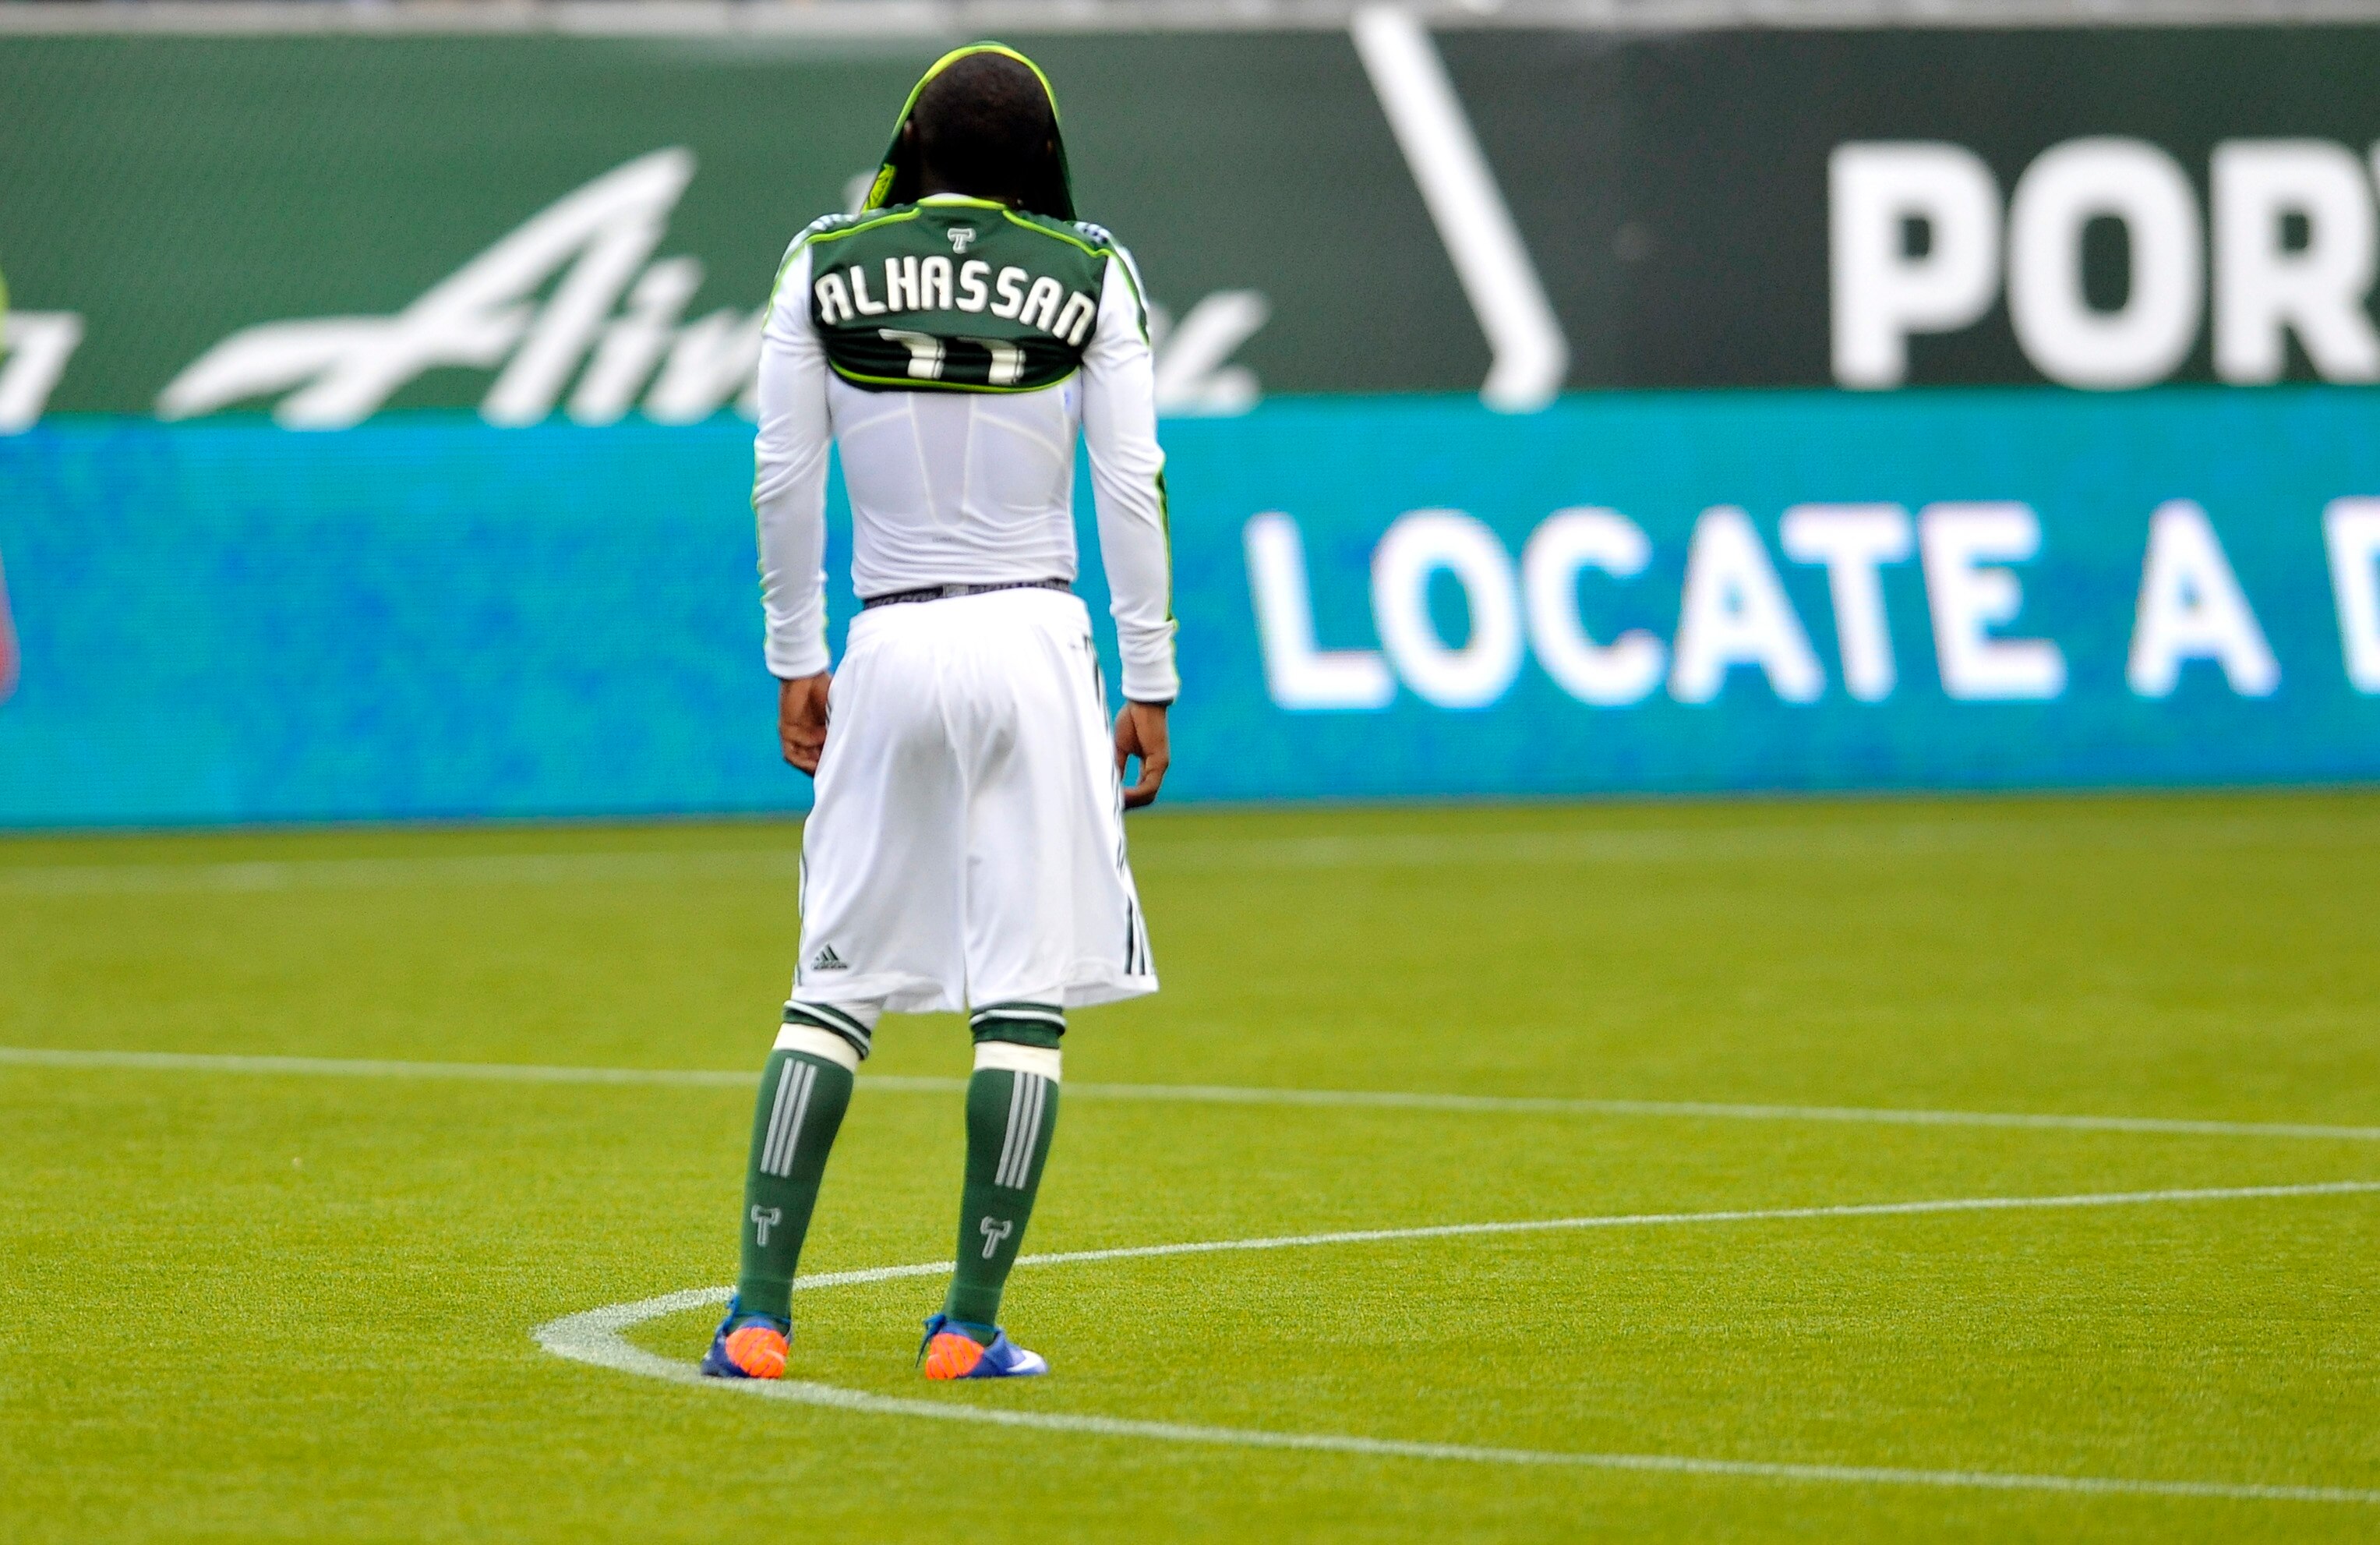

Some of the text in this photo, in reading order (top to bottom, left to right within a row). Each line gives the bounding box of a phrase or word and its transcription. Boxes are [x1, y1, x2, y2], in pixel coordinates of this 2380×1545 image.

[814, 255, 1096, 346] ALHASSAN
[1829, 135, 2380, 391] POR
[1244, 503, 2067, 711] LOCATE
[2125, 497, 2280, 697] A
